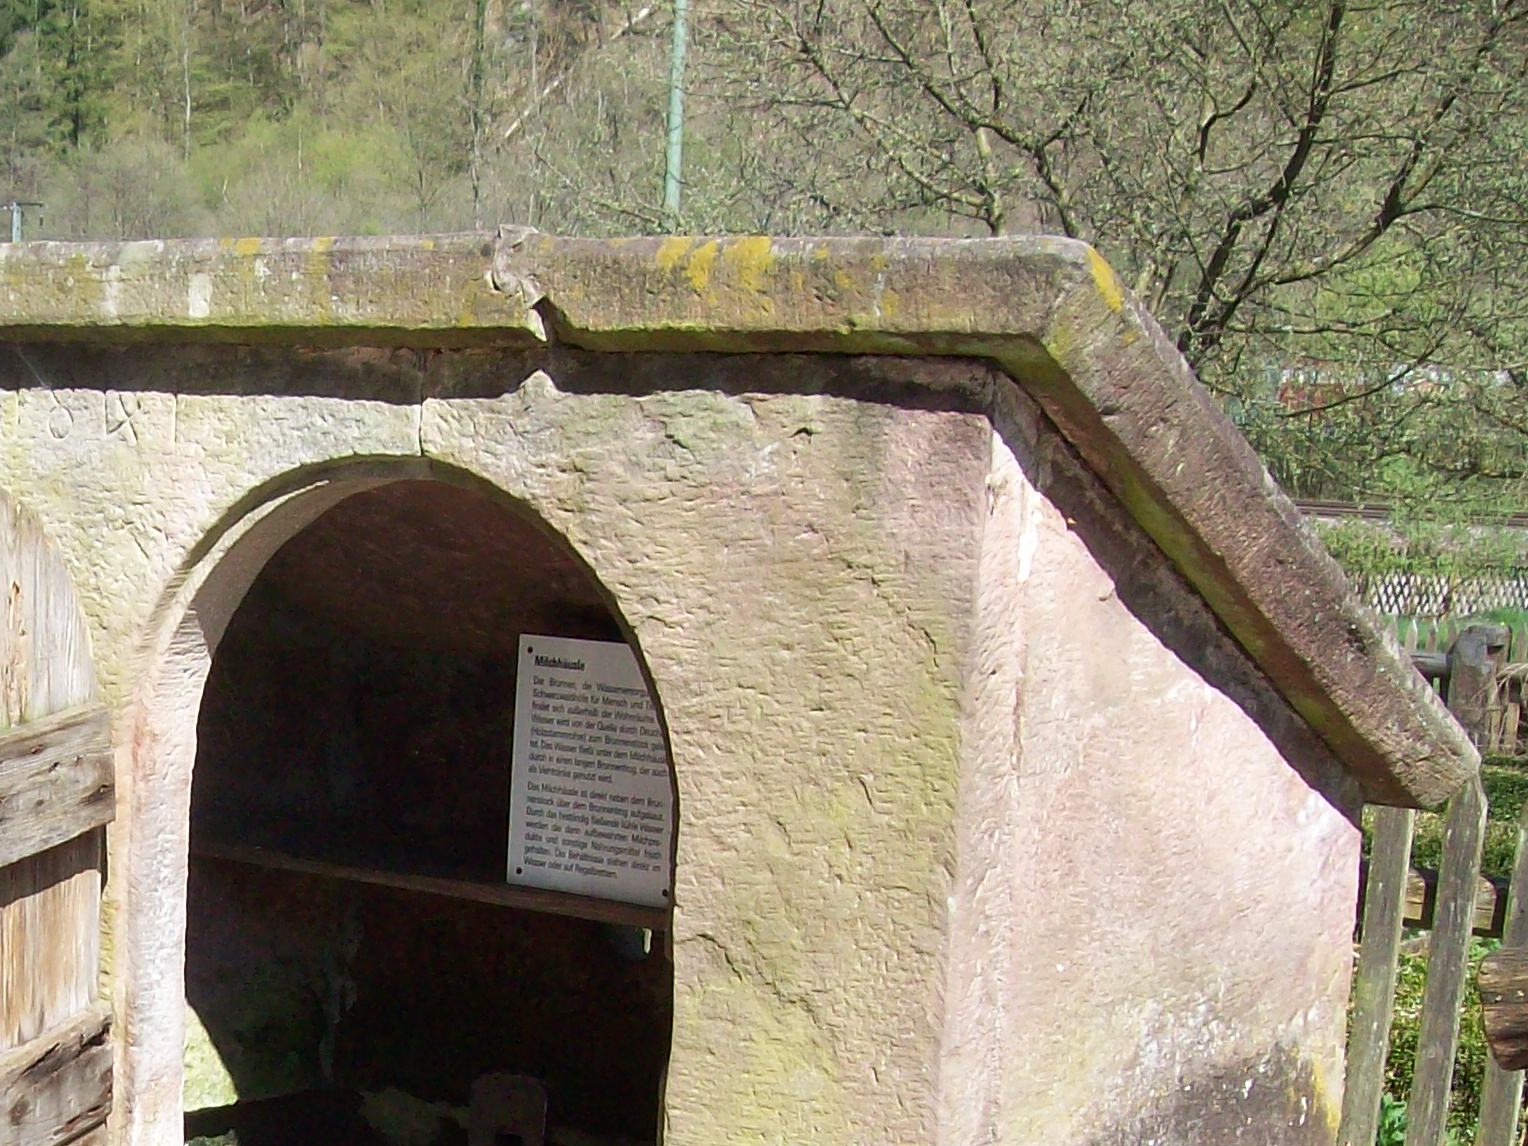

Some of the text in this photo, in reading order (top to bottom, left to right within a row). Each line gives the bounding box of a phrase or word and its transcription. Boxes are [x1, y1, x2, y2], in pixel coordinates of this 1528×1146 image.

[534, 675, 545, 685] Der
[602, 696, 627, 707] Mensch
[630, 700, 643, 709] und
[601, 709, 613, 718] der
[585, 720, 595, 729] der
[598, 722, 617, 732] Quelle
[541, 741, 553, 749] Das
[555, 742, 577, 752] Wasser
[614, 750, 628, 759] dem
[529, 752, 545, 761] durch
[640, 766, 649, 775] der
[528, 782, 540, 791] Das
[632, 795, 645, 805] dem
[573, 801, 587, 810] dem
[527, 807, 544, 817] Durch
[639, 823, 664, 834] Wasser
[546, 835, 558, 844] und
